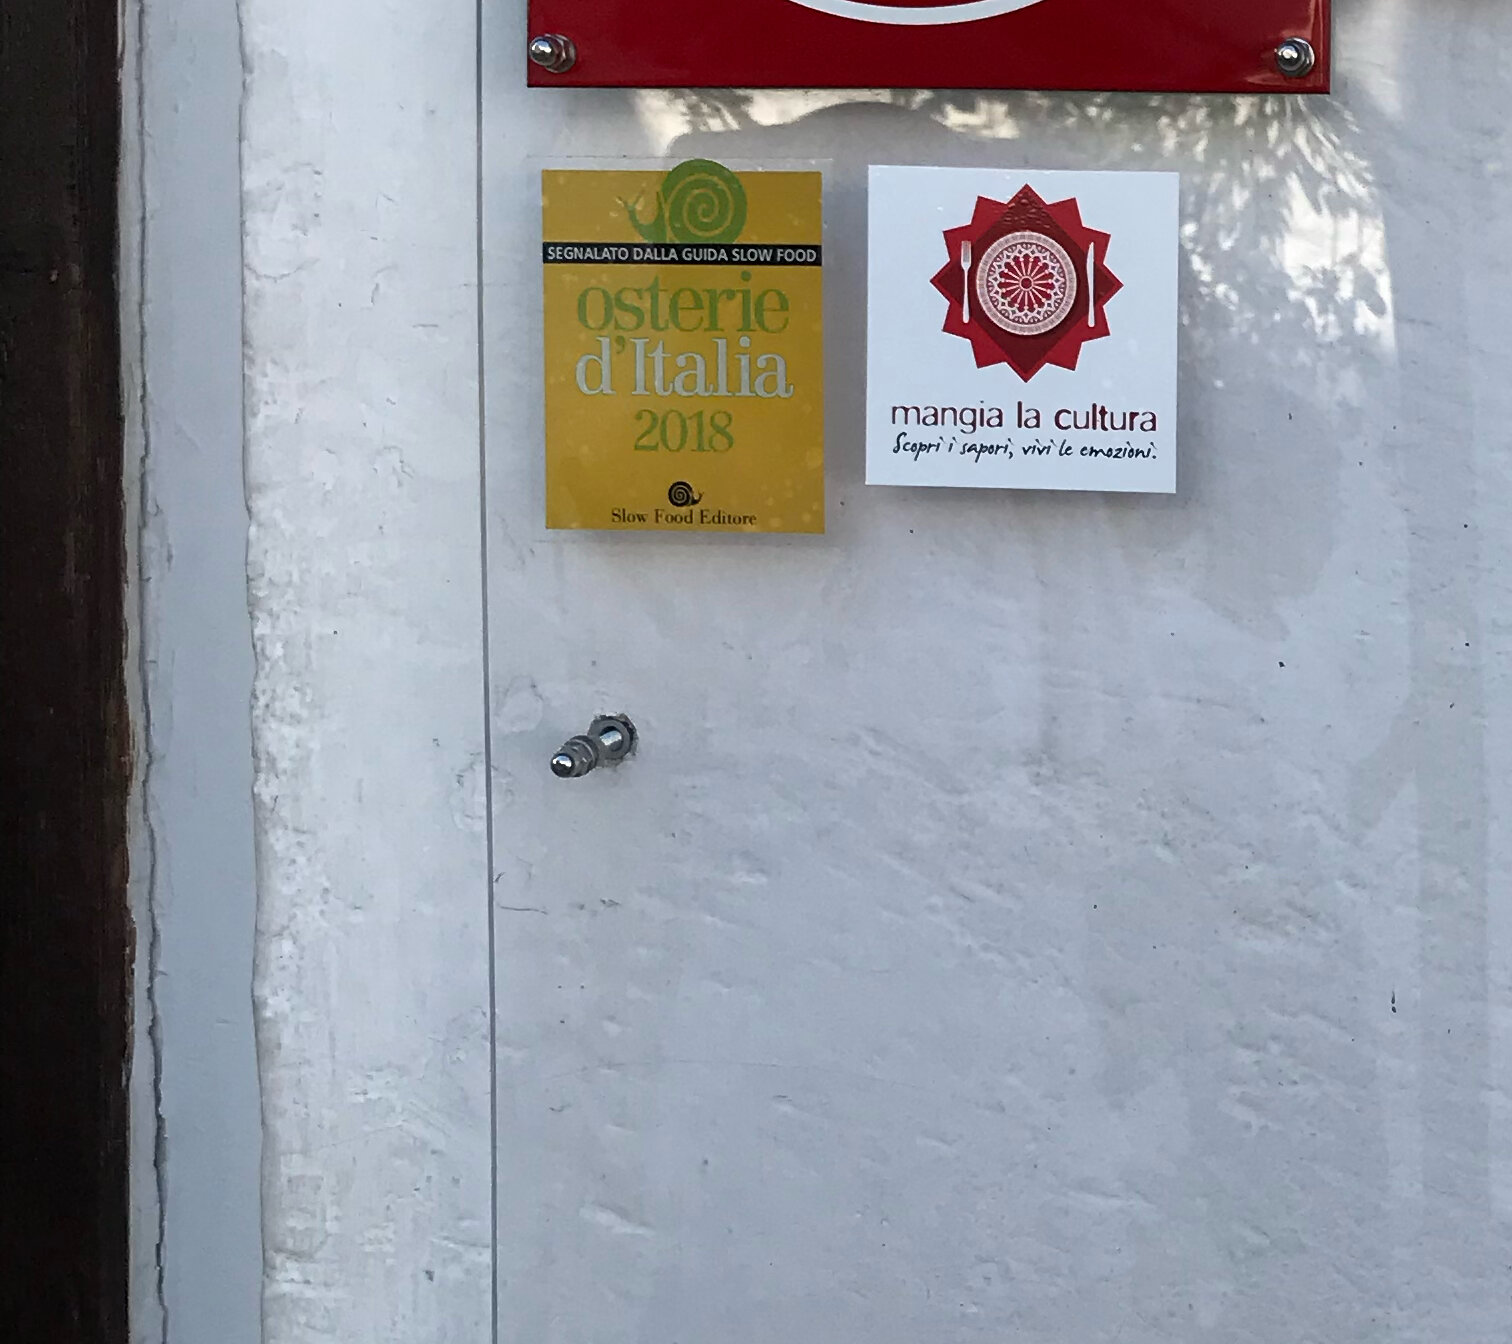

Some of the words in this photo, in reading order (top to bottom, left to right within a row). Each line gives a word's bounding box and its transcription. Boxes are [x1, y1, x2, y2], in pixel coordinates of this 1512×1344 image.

[547, 246, 629, 261] SEGNALATO
[633, 247, 679, 262] DALLA
[682, 247, 729, 263] GUIDA
[732, 248, 773, 263] SLOW
[776, 248, 817, 264] FOOD
[577, 270, 790, 334] osterie
[575, 335, 794, 399] d'Italia
[633, 409, 735, 454] 2018
[892, 400, 1004, 434] mangia
[1017, 400, 1041, 429] la
[1054, 402, 1157, 433] cultura
[893, 432, 945, 461] Scopri
[1022, 438, 1057, 456] vivi
[1058, 439, 1074, 457] le
[1080, 441, 1158, 460] emozioni.
[612, 507, 648, 526] Slow
[654, 508, 693, 525] Food
[699, 509, 757, 526] Editore
